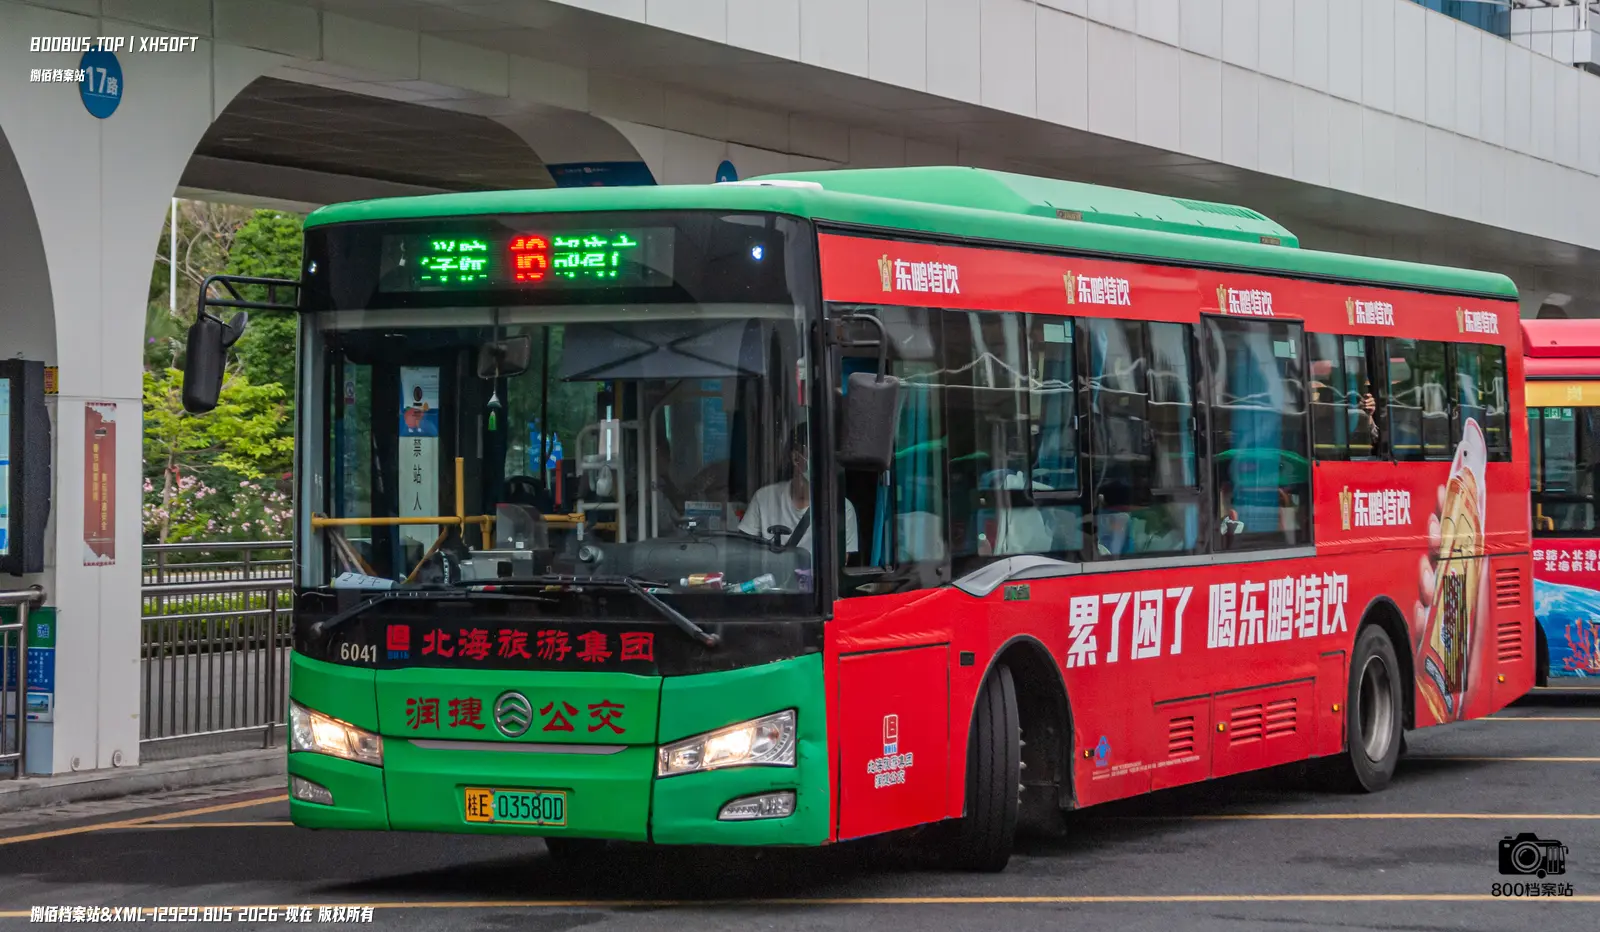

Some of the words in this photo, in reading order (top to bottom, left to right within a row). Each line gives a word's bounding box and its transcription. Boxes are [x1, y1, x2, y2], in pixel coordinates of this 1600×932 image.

[86, 66, 118, 96] 17路
[894, 258, 960, 294] 东鹏特饮
[1077, 274, 1131, 306] 东鹏特饮
[1228, 287, 1274, 316] 东鹏特饮
[1354, 299, 1395, 326] 东鹏特饮
[1464, 308, 1499, 335] 东鹏特饮
[1353, 488, 1412, 527] 东鹏特饮
[1066, 586, 1194, 669] 累了困了
[1207, 571, 1349, 650] 喝东鹏特饮
[340, 642, 378, 663] 6041
[421, 627, 656, 662] 北海旅游集团
[405, 697, 487, 730] 润捷
[540, 698, 627, 734] 公交
[468, 794, 489, 817] 桂E
[498, 795, 564, 820] 03580D
